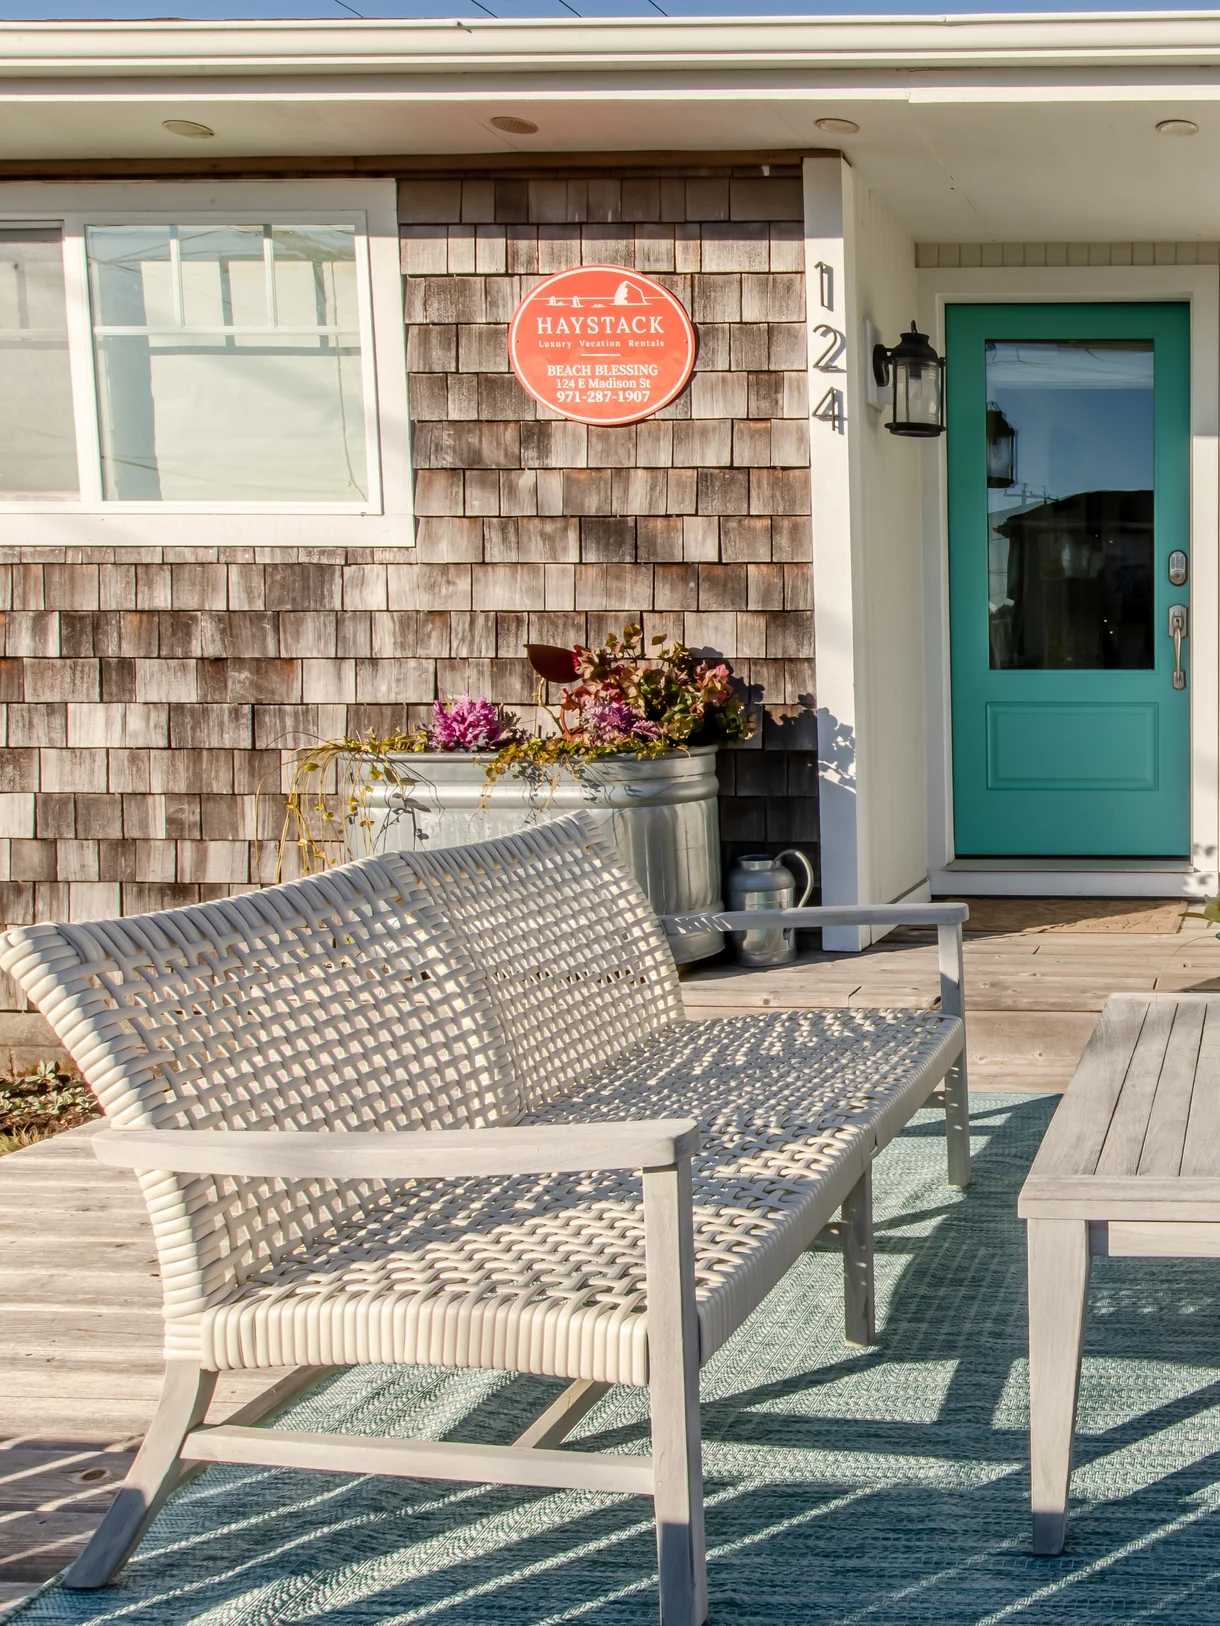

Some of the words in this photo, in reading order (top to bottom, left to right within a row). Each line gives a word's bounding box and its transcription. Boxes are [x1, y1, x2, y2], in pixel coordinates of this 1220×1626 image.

[537, 316, 664, 334] HAYSTACK
[538, 340, 572, 349] Luxury
[628, 339, 665, 347] Rentals
[812, 261, 842, 431] 124
[547, 365, 591, 376] BEACH
[595, 364, 658, 376] BLESSING
[556, 379, 576, 388] 124
[578, 379, 586, 388] E
[588, 378, 637, 388] Madison
[639, 378, 651, 388] St
[556, 391, 650, 403] 971-287-1907
